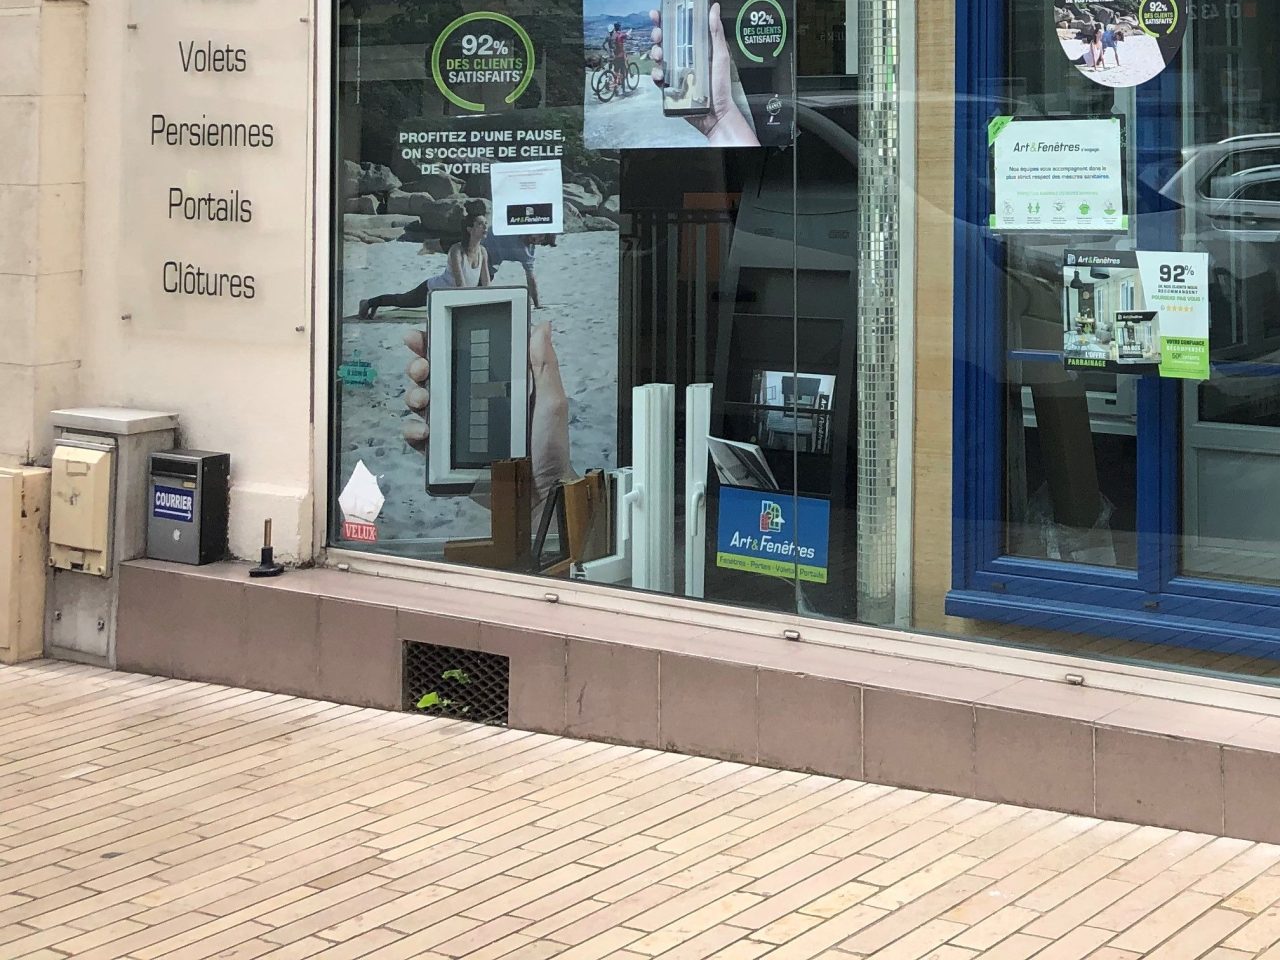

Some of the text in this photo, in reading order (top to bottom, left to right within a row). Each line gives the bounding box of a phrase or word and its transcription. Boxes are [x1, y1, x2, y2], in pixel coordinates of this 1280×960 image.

[1149, 2, 1167, 11] 92%
[750, 11, 774, 25] 92%
[743, 26, 781, 35] DES CLIENTS
[462, 34, 508, 55] 92%
[178, 40, 247, 72] Volets
[446, 58, 523, 70] DES CLIENTS
[151, 114, 274, 147] Persiennes
[399, 131, 466, 143] PROFITEZ
[517, 129, 566, 142] PAUSE,
[402, 148, 421, 159] ON
[498, 146, 516, 157] DE
[520, 145, 563, 156] CELLE
[1013, 142, 1080, 152] Art&Fenêtres
[421, 164, 440, 175] DE
[444, 163, 490, 174] VOTRE
[168, 187, 252, 222] Portails
[163, 261, 256, 299] Clôtures
[1159, 264, 1195, 283] 92%
[155, 491, 192, 510] COURRIER
[345, 523, 376, 540] VELUX
